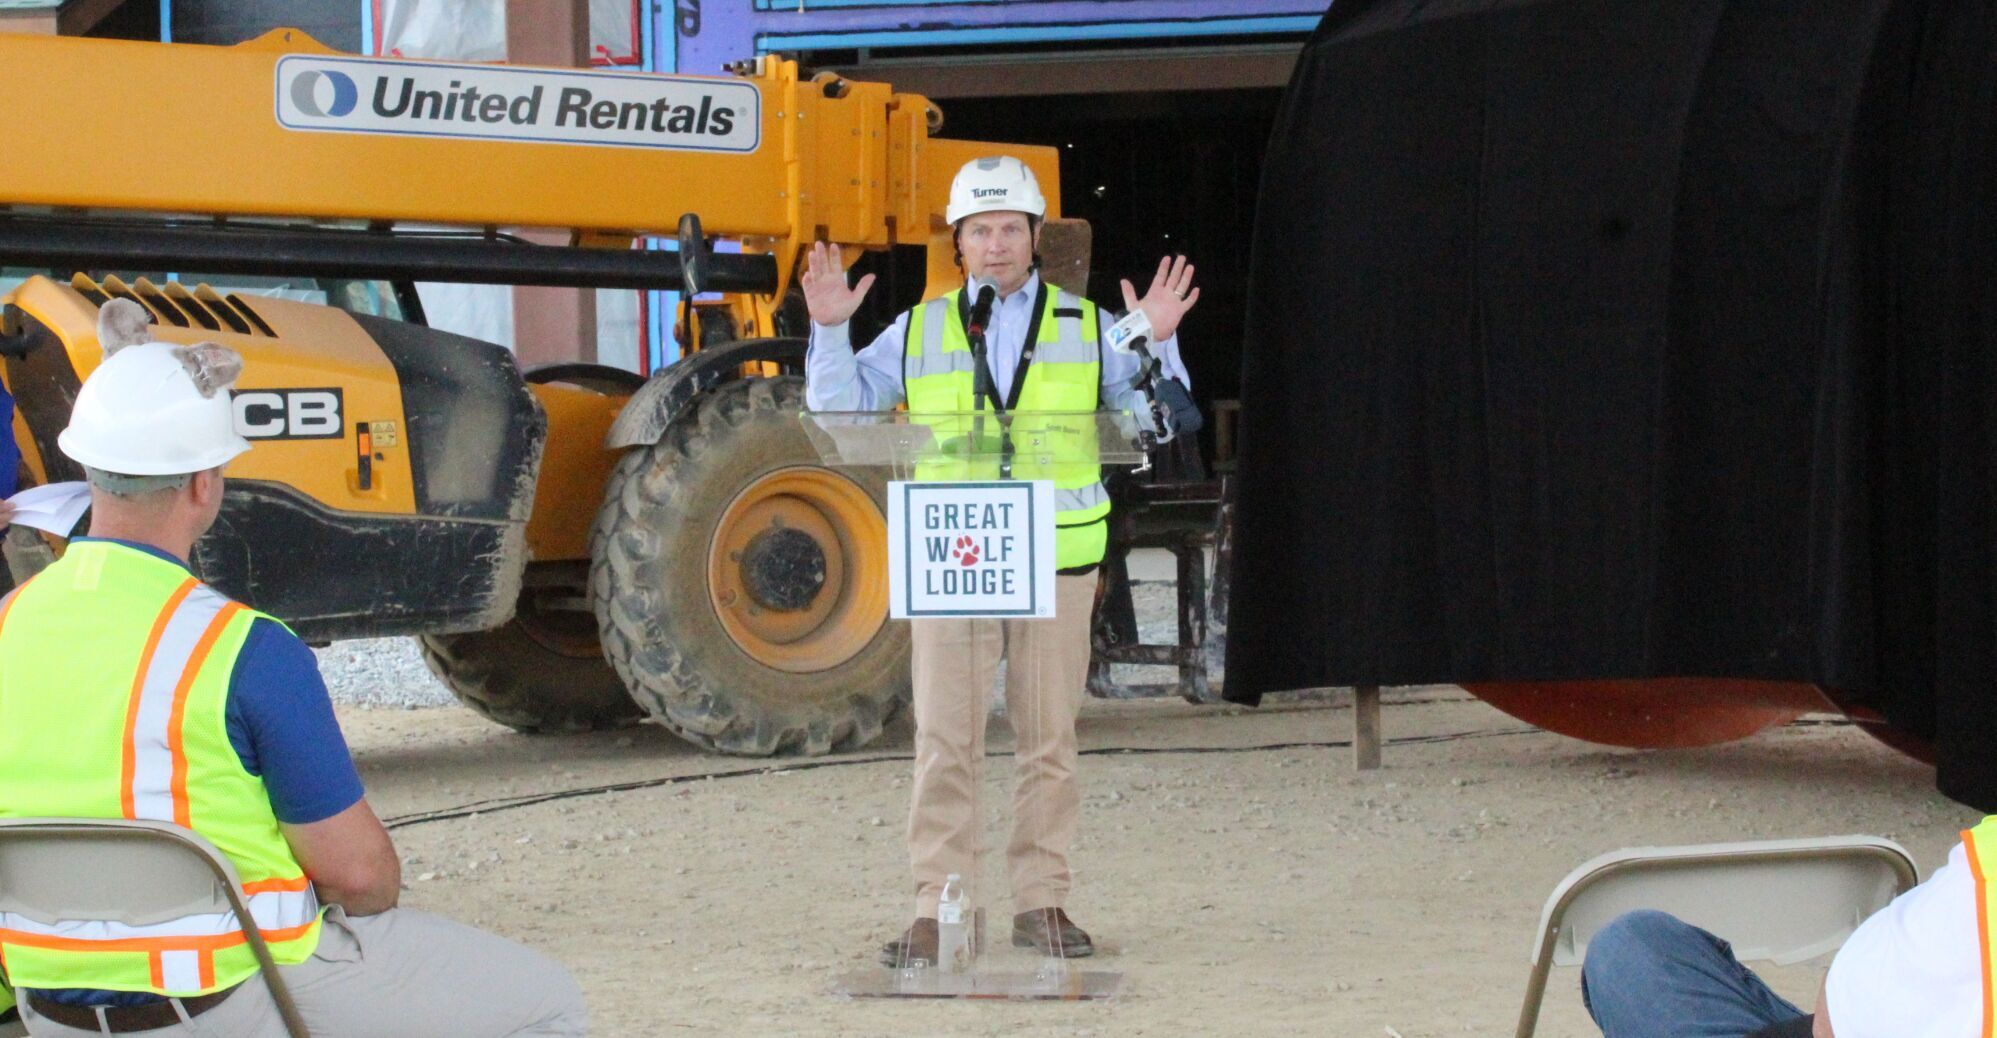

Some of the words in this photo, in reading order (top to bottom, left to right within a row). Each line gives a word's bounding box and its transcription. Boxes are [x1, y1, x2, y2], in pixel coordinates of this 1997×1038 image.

[371, 76, 544, 126] United
[555, 86, 735, 136] Rentals
[971, 187, 1008, 199] Turner
[232, 391, 341, 437] CB
[925, 503, 1014, 530] GREAT
[926, 568, 1016, 595] LODGE
